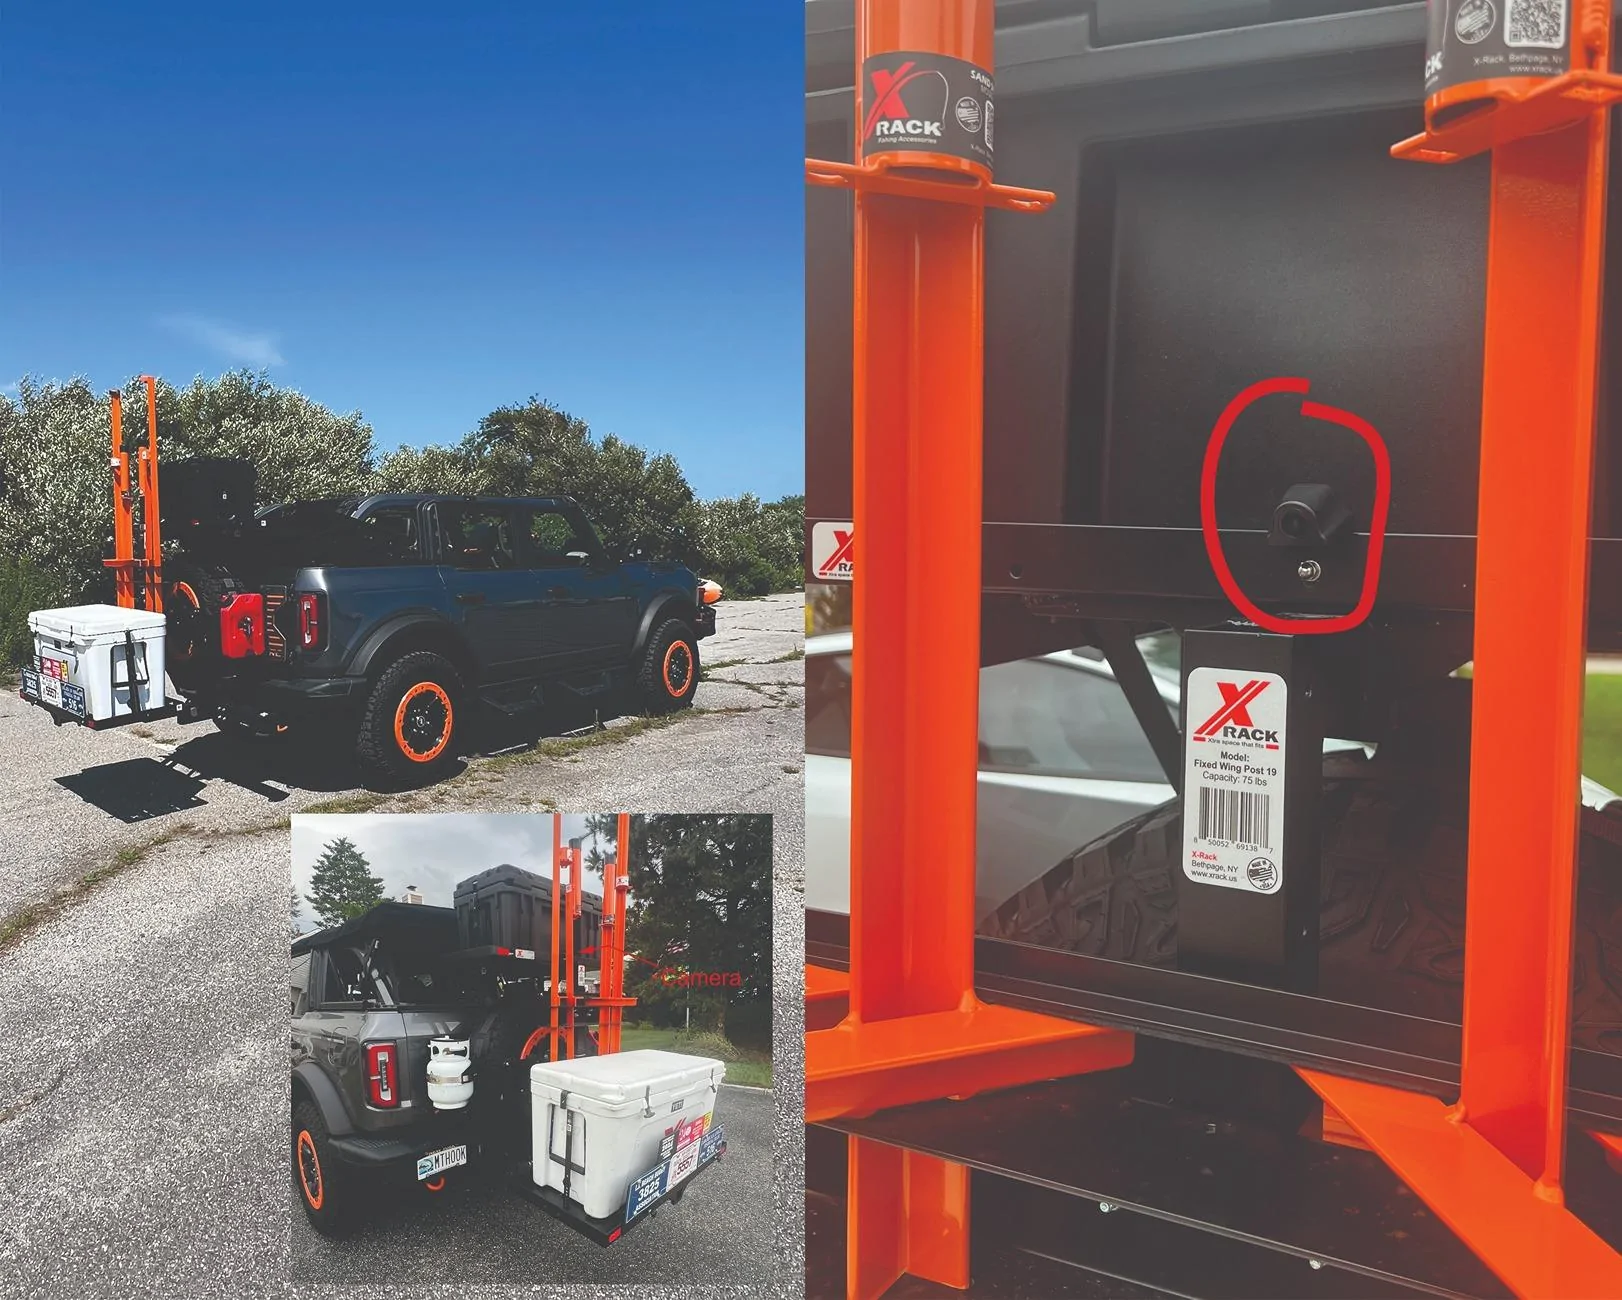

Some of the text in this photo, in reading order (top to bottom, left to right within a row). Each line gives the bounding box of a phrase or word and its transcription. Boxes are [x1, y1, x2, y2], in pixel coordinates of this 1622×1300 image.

[863, 61, 917, 139] X
[876, 119, 942, 136] RACK
[838, 562, 854, 571] RA
[1193, 680, 1271, 736] X
[1223, 726, 1279, 743] RACK
[1220, 751, 1249, 762] Model:
[1194, 759, 1277, 776] Fixed Wing Post 19
[1202, 771, 1267, 786] Capacity: 75 lbs
[1208, 839, 1229, 848] 50052
[1236, 844, 1258, 852] 69138
[1192, 851, 1217, 861] X-Rack
[1191, 860, 1225, 872] Bethpage,
[1191, 870, 1237, 882] www.xrack.us
[434, 1147, 466, 1170] MTHOOK
[638, 1177, 660, 1201] 3825
